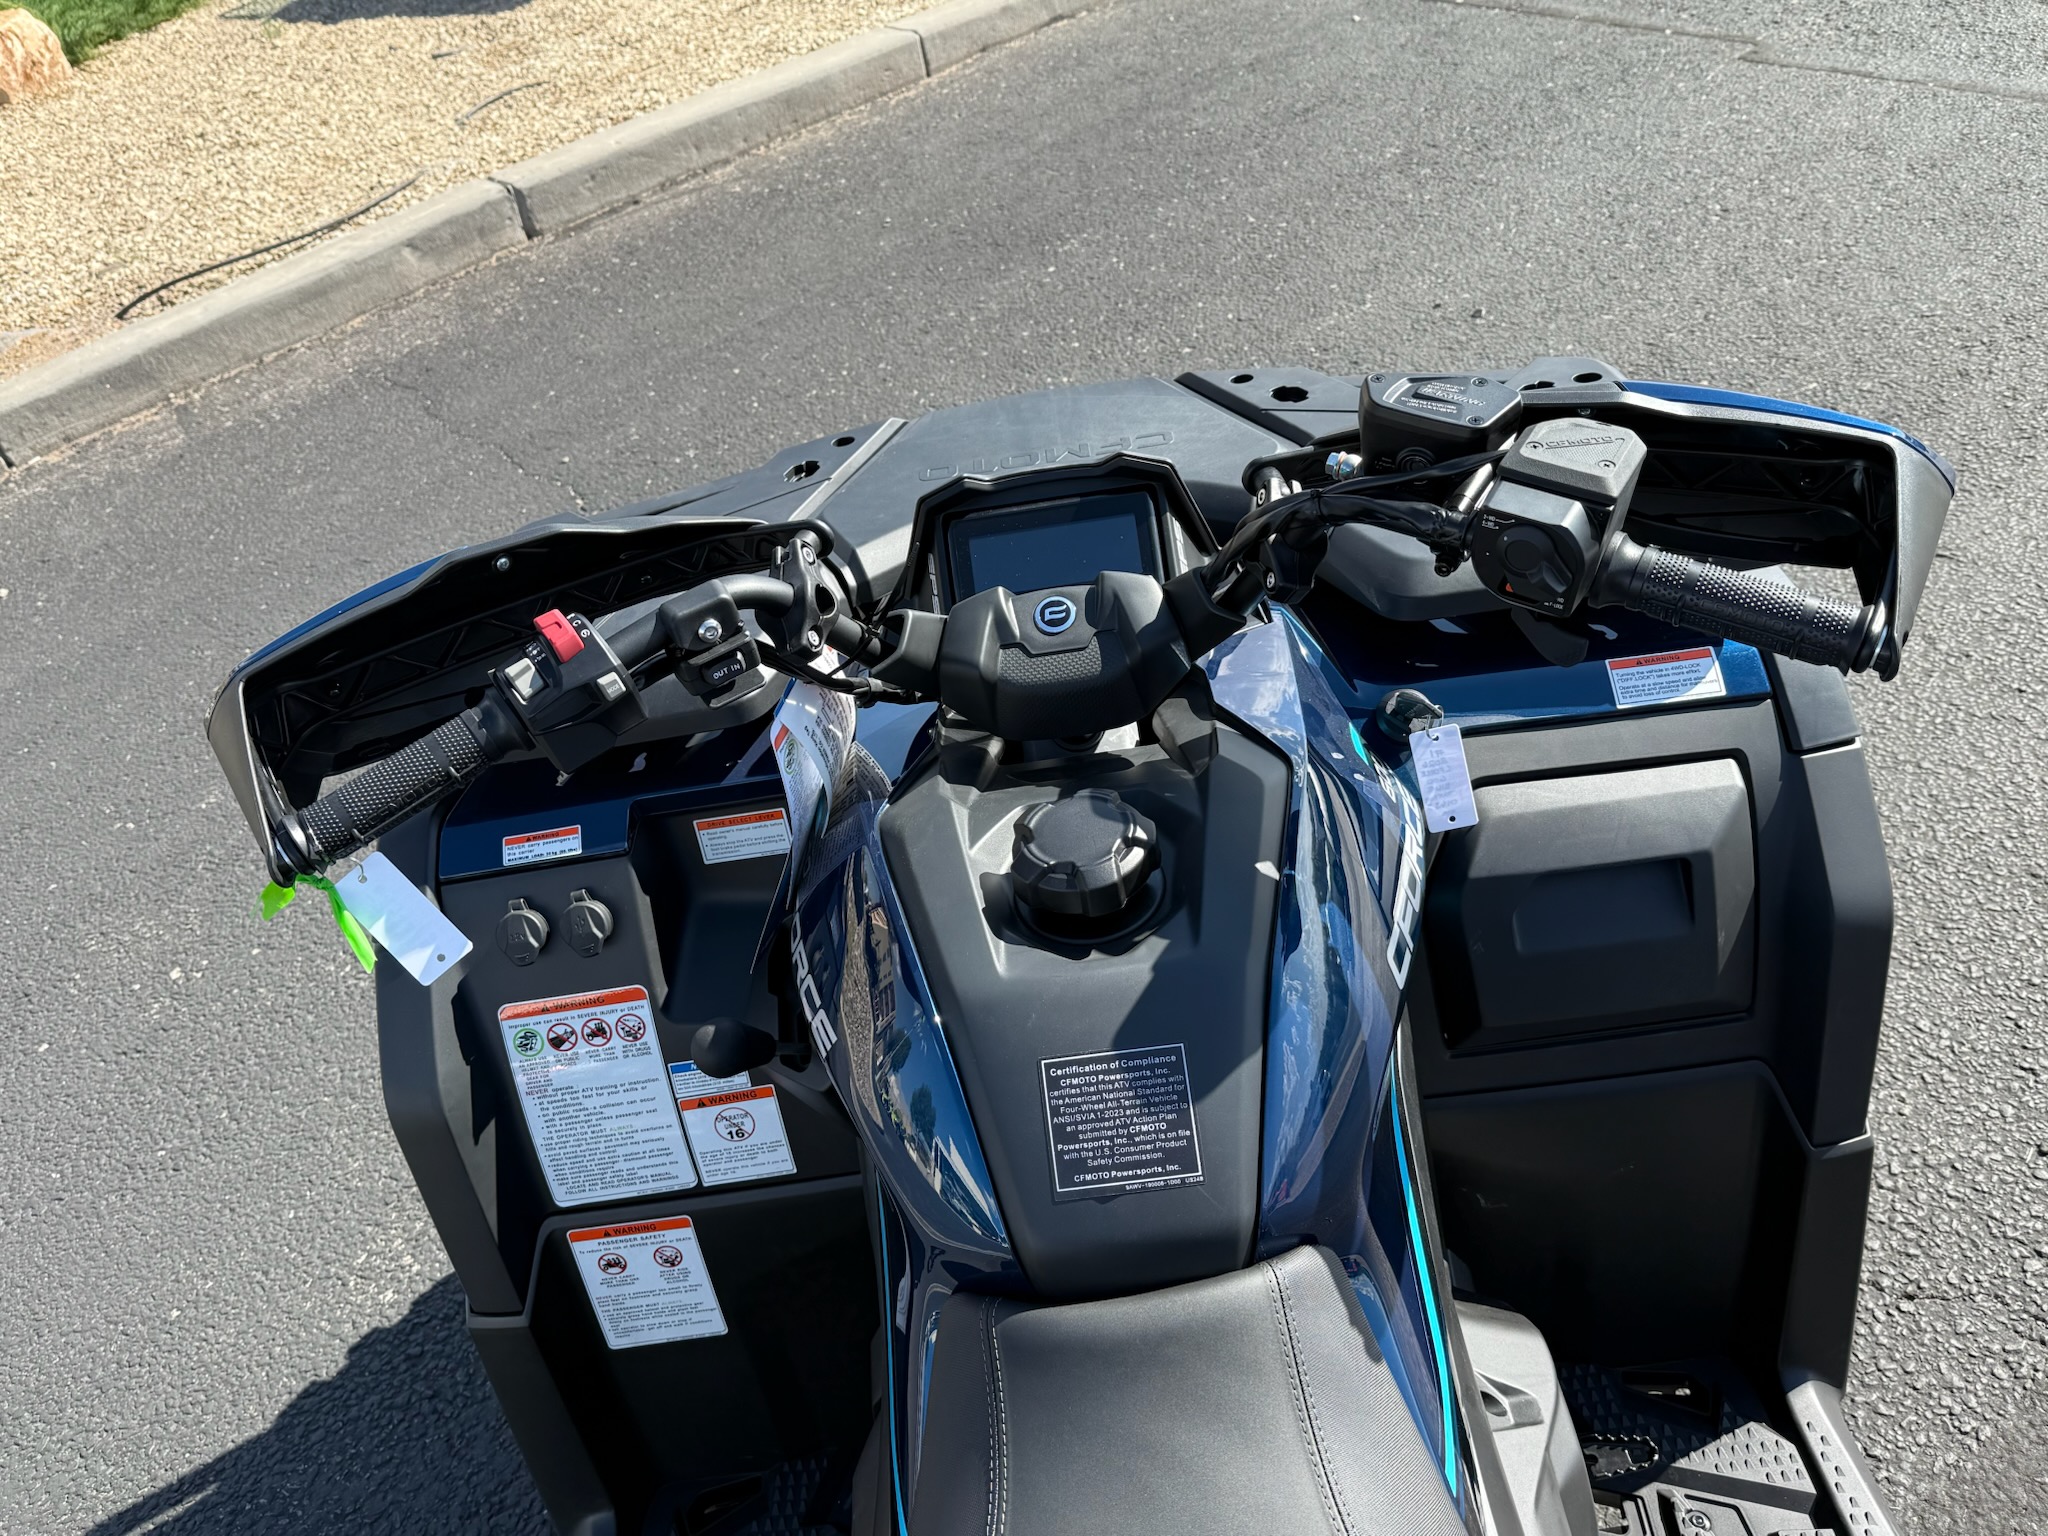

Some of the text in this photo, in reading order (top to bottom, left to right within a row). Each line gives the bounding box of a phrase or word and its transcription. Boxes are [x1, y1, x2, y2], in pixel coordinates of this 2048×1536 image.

[1546, 435, 1613, 448] CFMOTO
[919, 430, 1175, 481] CFMOTO
[1644, 654, 1679, 663] WARNING
[713, 663, 740, 679] OUT IN
[533, 831, 558, 840] WARNING
[542, 837, 570, 846] passengers
[1387, 775, 1424, 990] CFORCE
[791, 908, 838, 1060] ORCE
[554, 995, 604, 1009] WARNING
[1050, 1054, 1176, 1076] Certification of Compliance
[1060, 1075, 1096, 1086] CFMOTO
[1098, 1069, 1153, 1081] Powersports,
[1050, 1088, 1079, 1097] certifies
[1114, 1081, 1129, 1089] ATV
[1131, 1077, 1165, 1086] complies
[1064, 1094, 1100, 1104] American
[1103, 1089, 1135, 1099] National
[1137, 1084, 1172, 1095] Standard
[709, 1090, 756, 1104] WARNING
[1060, 1093, 1177, 1113] Four-Wheel All-Terrain Vehicle
[564, 1118, 592, 1126] passenger
[615, 1111, 643, 1119] passenger
[716, 1112, 748, 1122] OPERATOR
[1052, 1112, 1094, 1124] ANSI/SVIA
[1097, 1108, 1123, 1118] 1-2023
[1126, 1106, 1139, 1114] and
[1150, 1102, 1178, 1112] subject
[724, 1120, 745, 1129] UNDER
[1077, 1119, 1113, 1131] approved
[1115, 1116, 1132, 1125] ATV
[1133, 1115, 1157, 1123] Action
[1079, 1128, 1116, 1139] submitted
[1130, 1122, 1166, 1133] CFMOTO
[556, 1130, 588, 1139] OPERATOR
[727, 1128, 744, 1139] 16
[1057, 1139, 1112, 1151] Powersports,
[1134, 1132, 1156, 1142] which
[1064, 1151, 1078, 1160] with
[1114, 1143, 1154, 1153] Consumer
[1156, 1138, 1186, 1148] Product
[1087, 1152, 1164, 1166] Safety Commission.
[1074, 1171, 1108, 1182] CFMOTO
[1111, 1165, 1165, 1177] Powersports,
[613, 1223, 656, 1235] WARNING
[597, 1237, 637, 1246] PASSENGER
